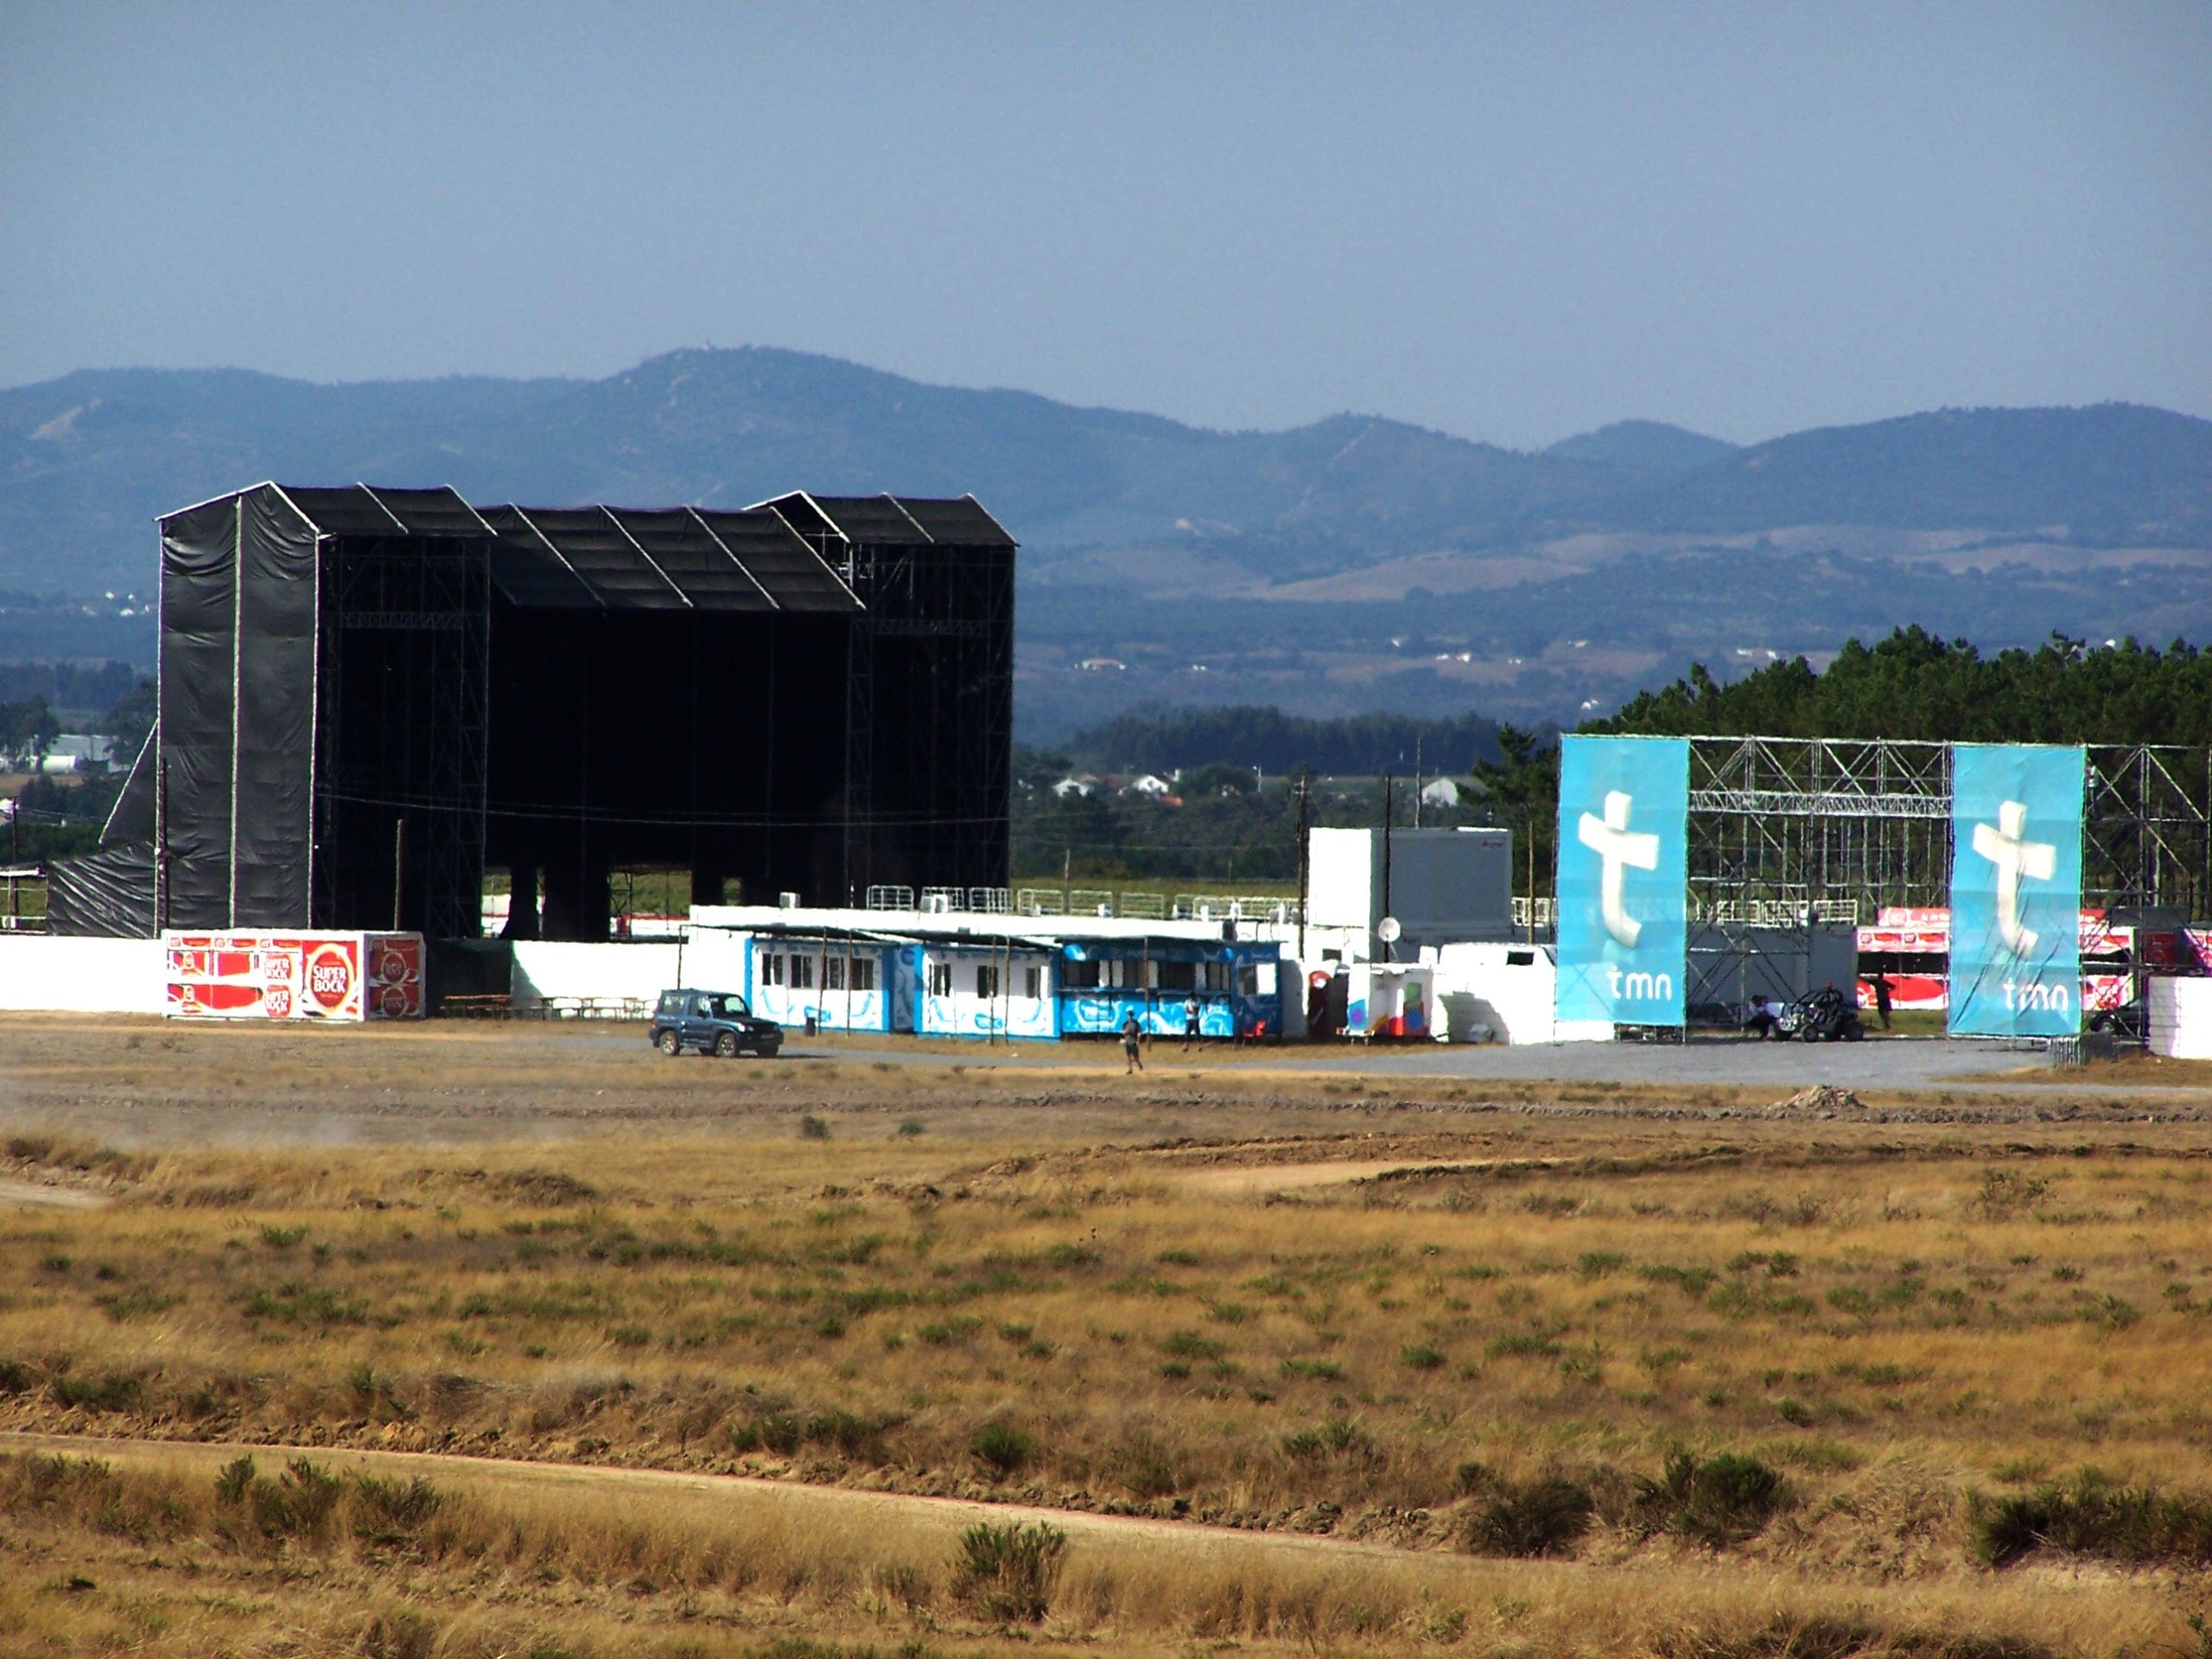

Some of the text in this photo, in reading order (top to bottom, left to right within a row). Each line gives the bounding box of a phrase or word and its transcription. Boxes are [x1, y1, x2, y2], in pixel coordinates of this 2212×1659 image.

[1579, 790, 1660, 949] t
[1973, 800, 2055, 958] t
[314, 965, 346, 980] SUPER
[314, 979, 345, 993] BOCK
[1606, 965, 1672, 1001] tmn
[2004, 977, 2069, 1011] tmn
